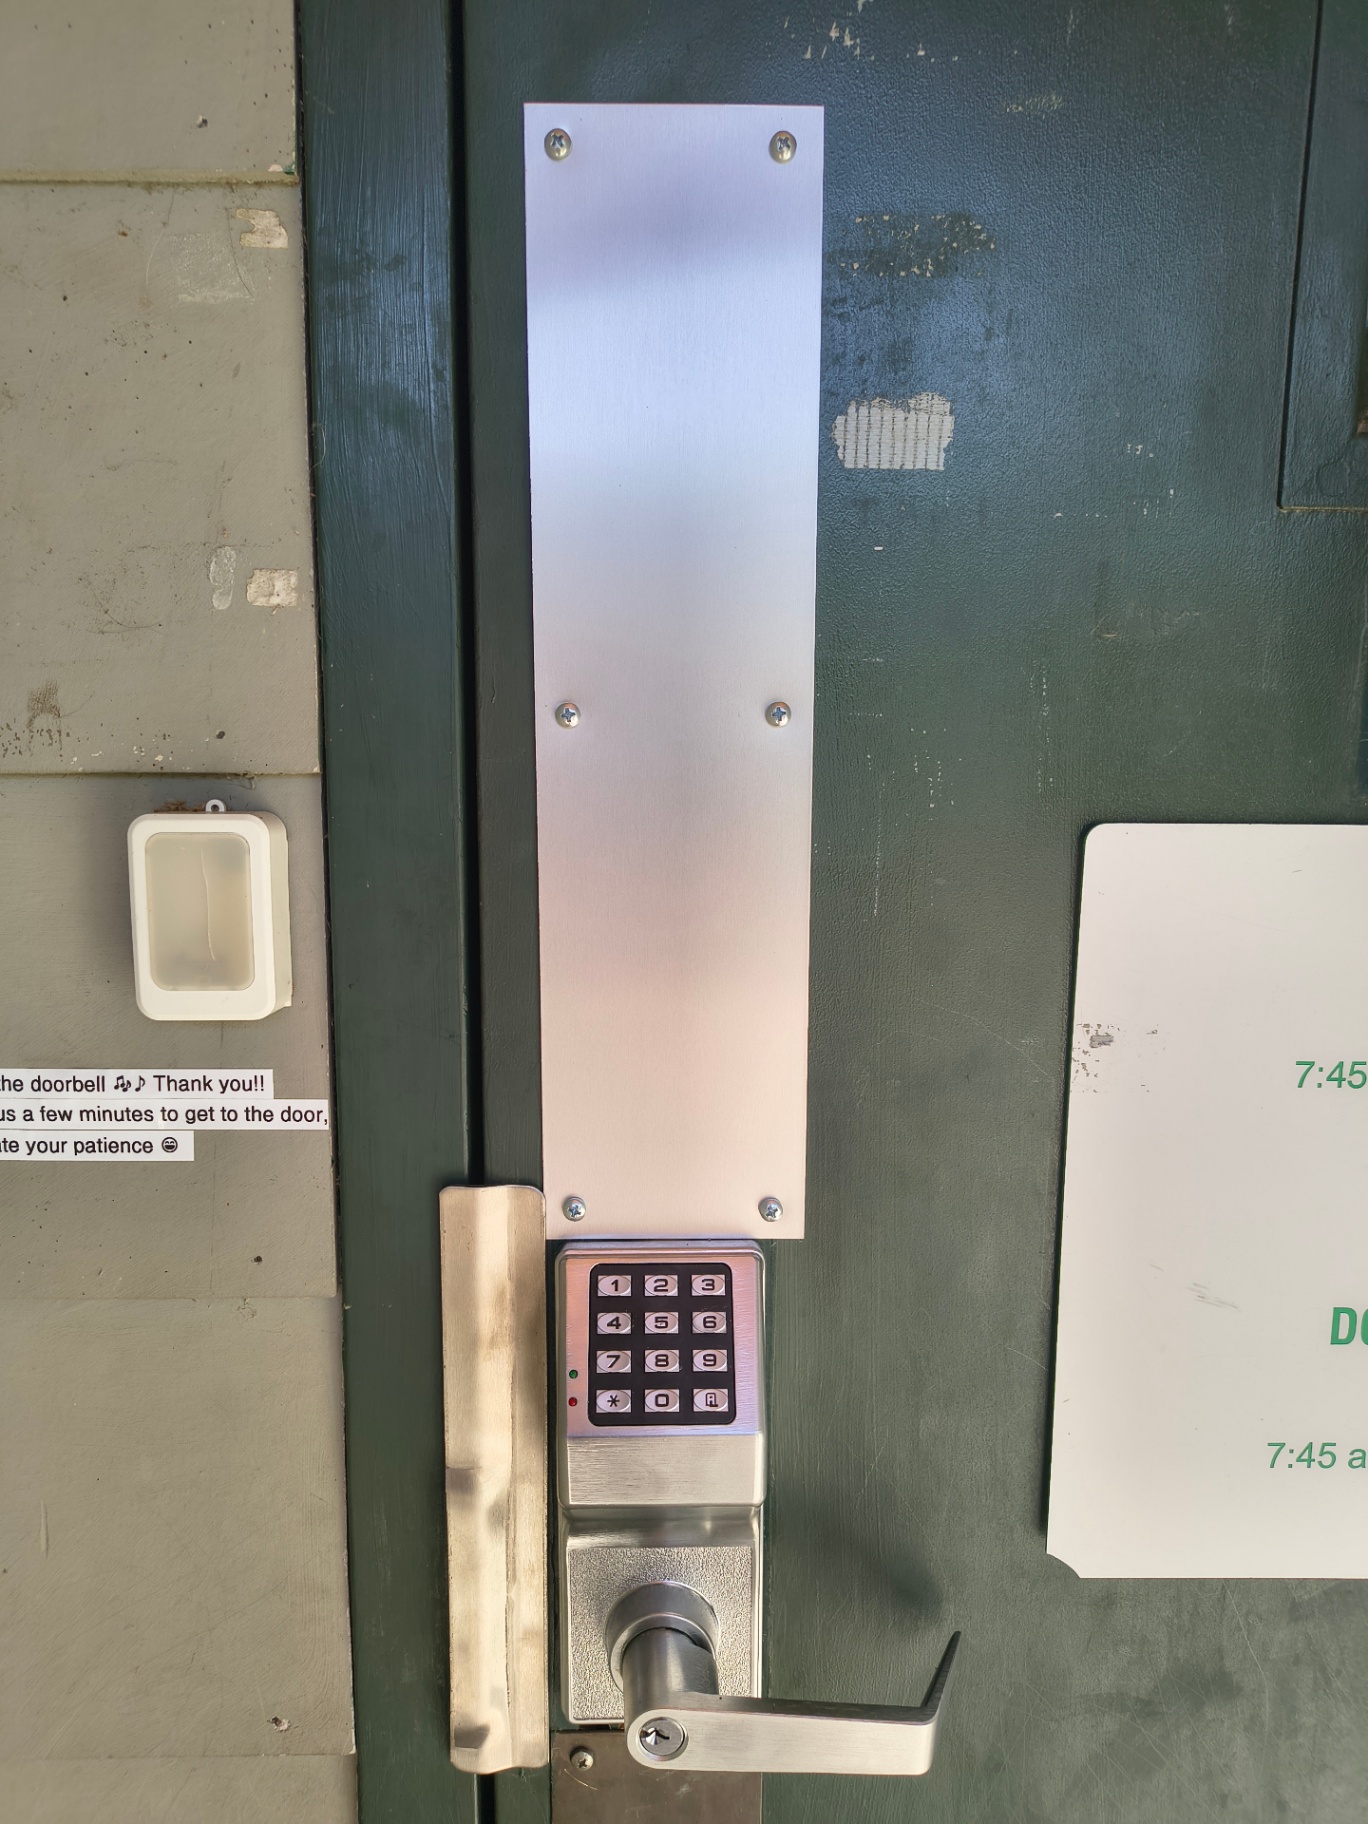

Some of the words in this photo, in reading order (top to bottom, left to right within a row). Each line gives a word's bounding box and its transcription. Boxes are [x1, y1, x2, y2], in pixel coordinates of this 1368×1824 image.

[0, 1074, 24, 1092] he
[30, 1074, 106, 1093] doorbell
[153, 1075, 213, 1092] Thank
[219, 1075, 265, 1094] you!!
[1295, 1061, 1367, 1089] 7:45
[23, 1109, 35, 1122] a
[39, 1105, 73, 1122] few
[79, 1105, 154, 1122] minutes
[160, 1106, 179, 1122] to
[185, 1107, 215, 1125] get
[220, 1106, 238, 1122] to
[244, 1105, 274, 1122] the
[280, 1105, 329, 1125] door,
[0, 1137, 20, 1153] te
[25, 1140, 68, 1156] your
[73, 1136, 154, 1156] patience
[611, 1279, 619, 1292] 1
[653, 1278, 669, 1292] 2
[701, 1278, 715, 1291] 3
[607, 1316, 621, 1329] 4
[654, 1316, 669, 1329] 5
[703, 1316, 717, 1328] 6
[607, 1355, 621, 1368] 7
[654, 1353, 670, 1368] 8
[703, 1353, 717, 1367] 9
[1267, 1442, 1337, 1469] 7:45
